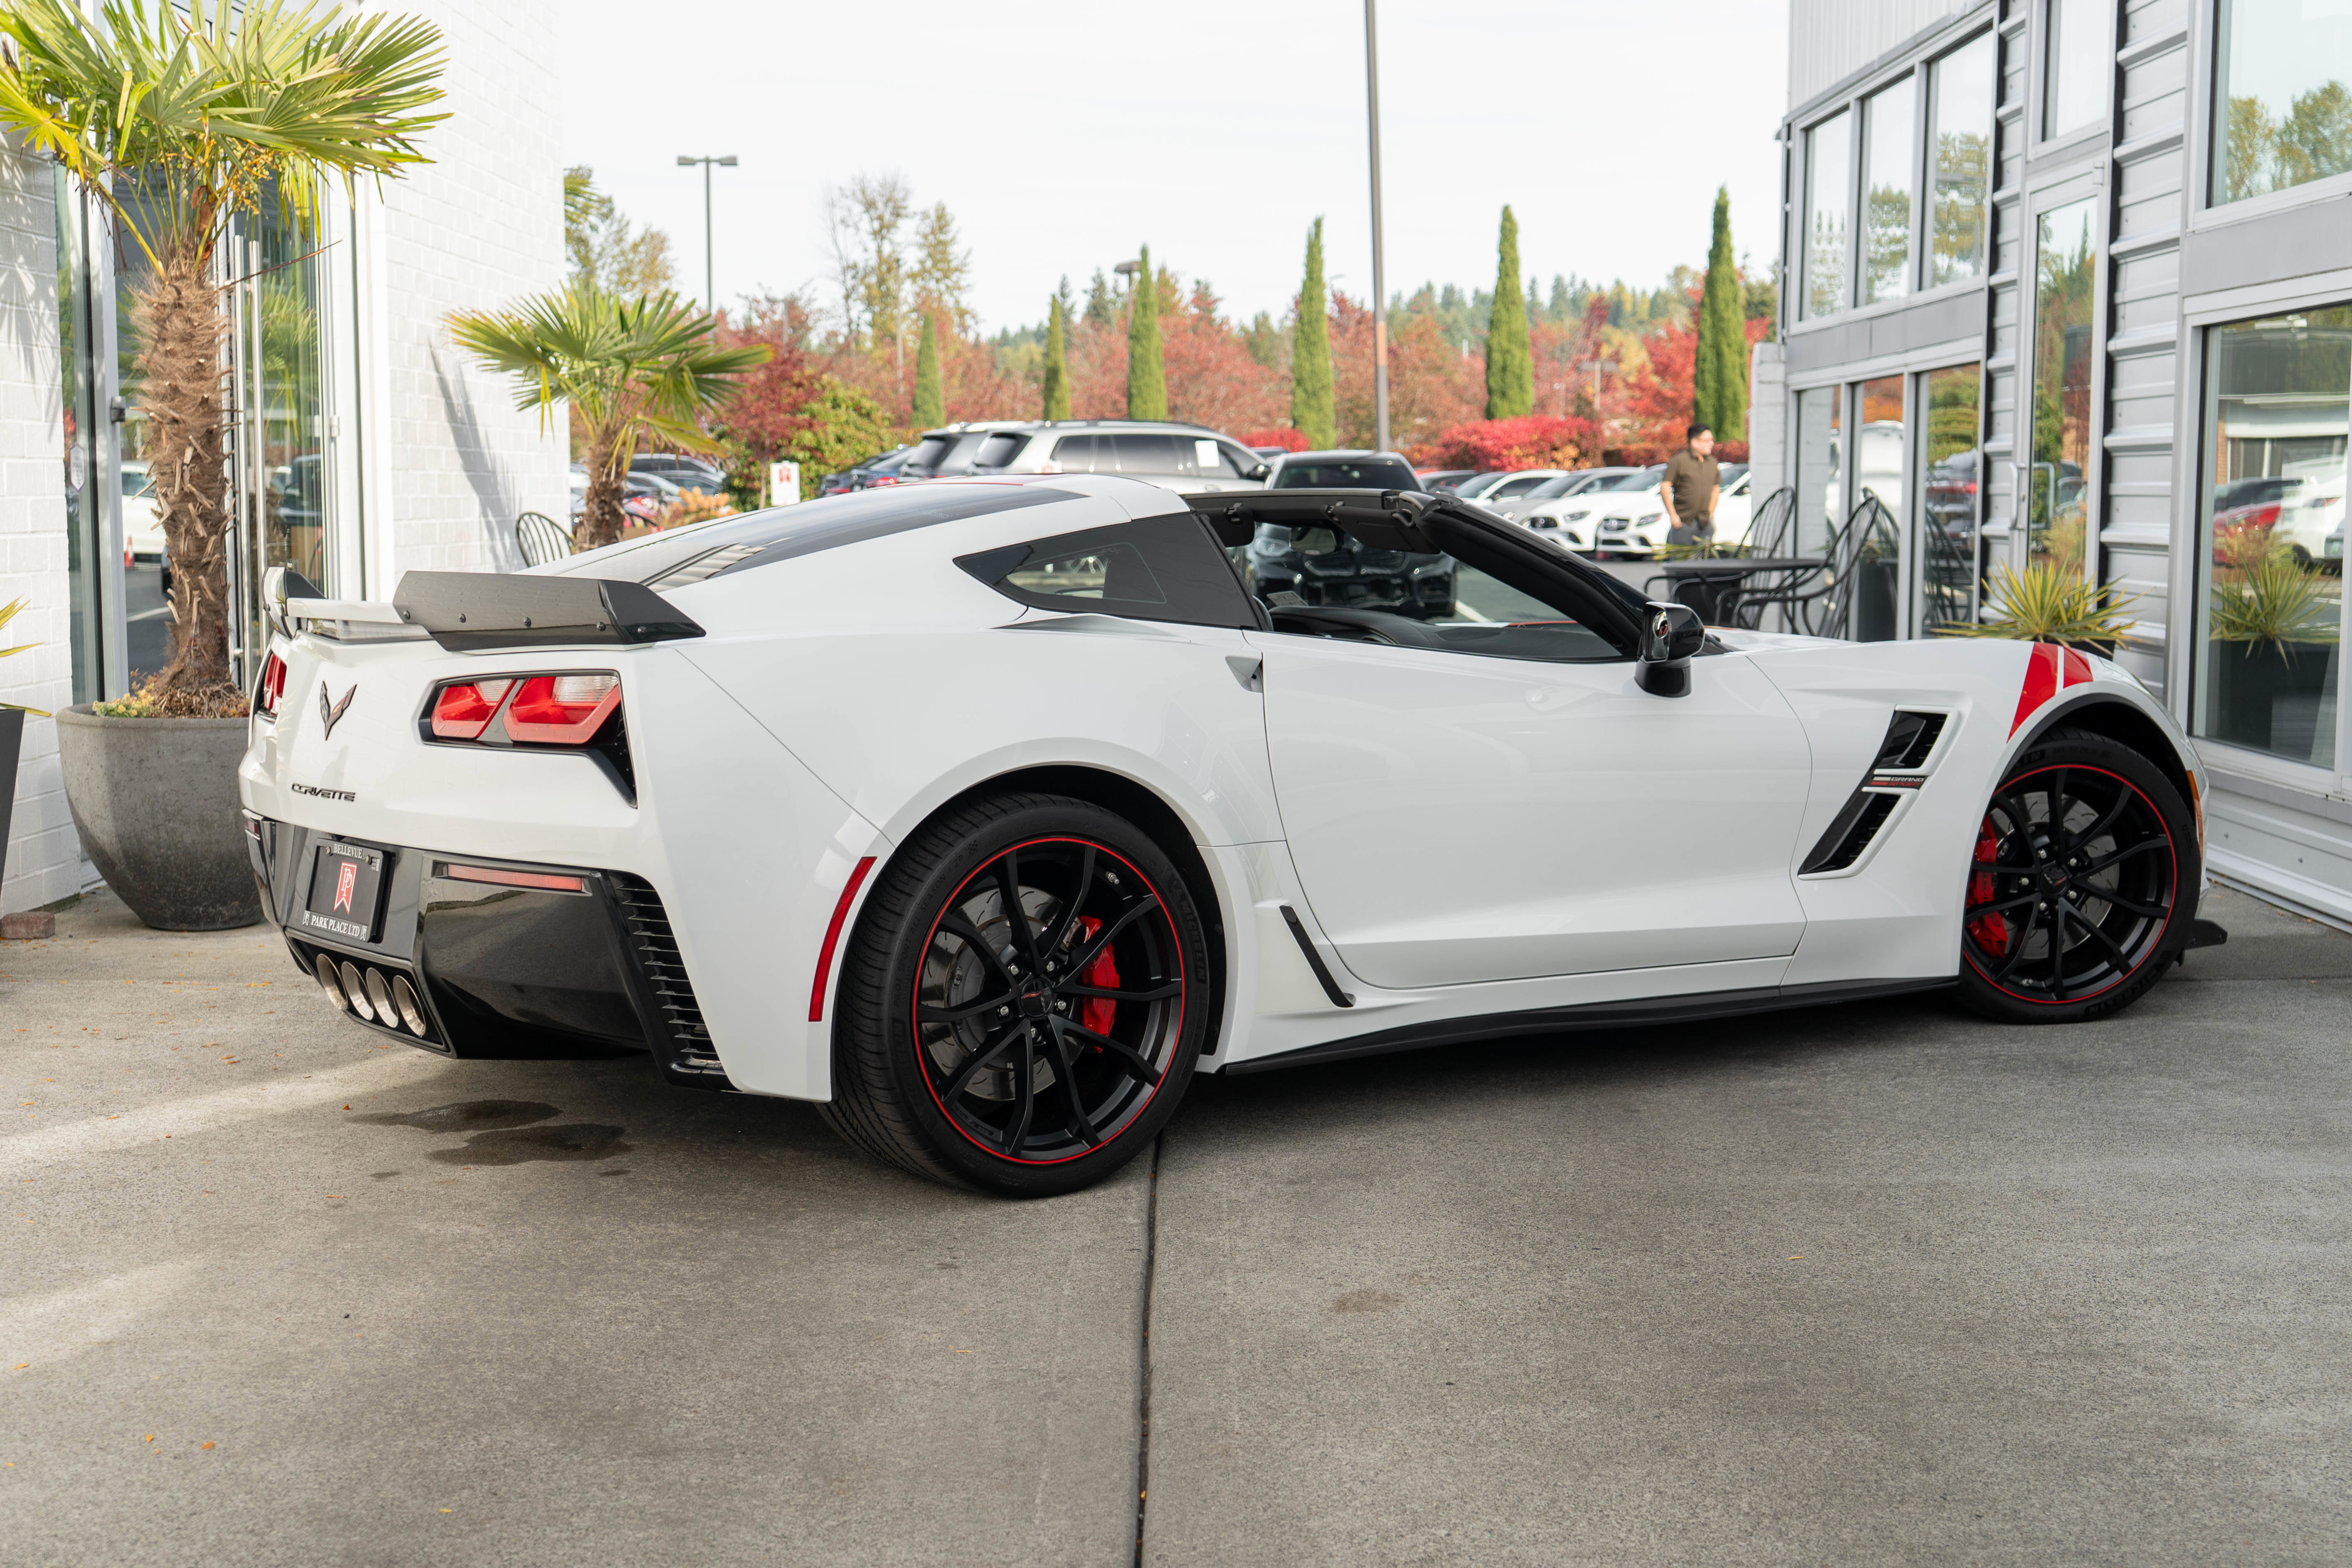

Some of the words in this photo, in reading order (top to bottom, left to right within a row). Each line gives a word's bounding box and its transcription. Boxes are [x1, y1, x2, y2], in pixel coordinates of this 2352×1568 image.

[291, 783, 356, 802] CORVETTE
[333, 843, 363, 859] BELLEVUE
[311, 915, 328, 930] PARK
[328, 919, 348, 934] PLACE
[348, 925, 360, 937] LTD
[893, 978, 901, 1006] PILOT
[900, 939, 912, 972] SPORT
[909, 915, 922, 935] ALL
[920, 875, 947, 913] SEASON
[1179, 900, 1206, 981] MICHELIN
